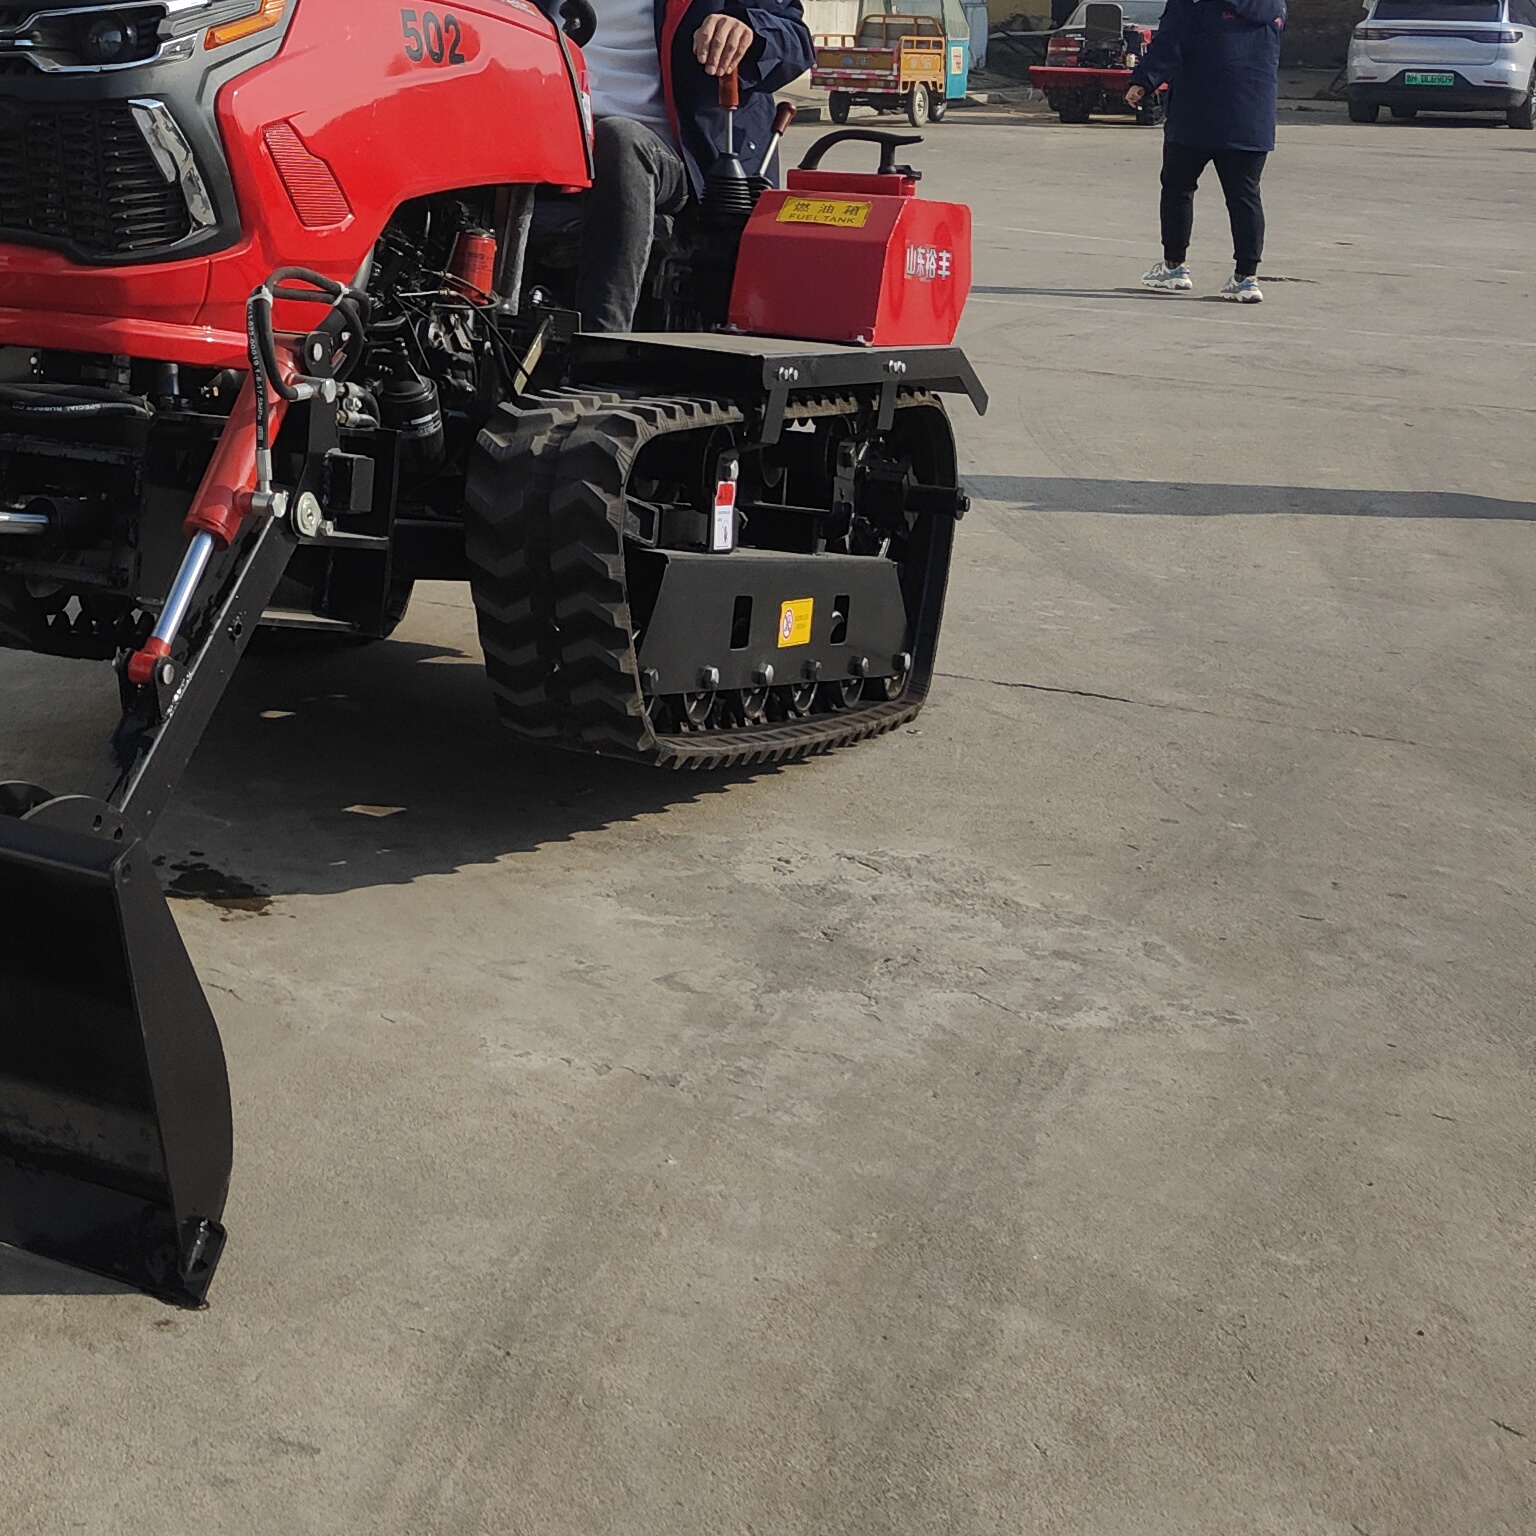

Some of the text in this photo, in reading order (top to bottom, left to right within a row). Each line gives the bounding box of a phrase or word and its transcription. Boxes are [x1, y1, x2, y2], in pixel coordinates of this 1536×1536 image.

[401, 9, 465, 64] 502
[788, 213, 856, 224] FUEL TANK
[793, 202, 861, 216] 燃油箱
[906, 244, 951, 280] 山东裕丰
